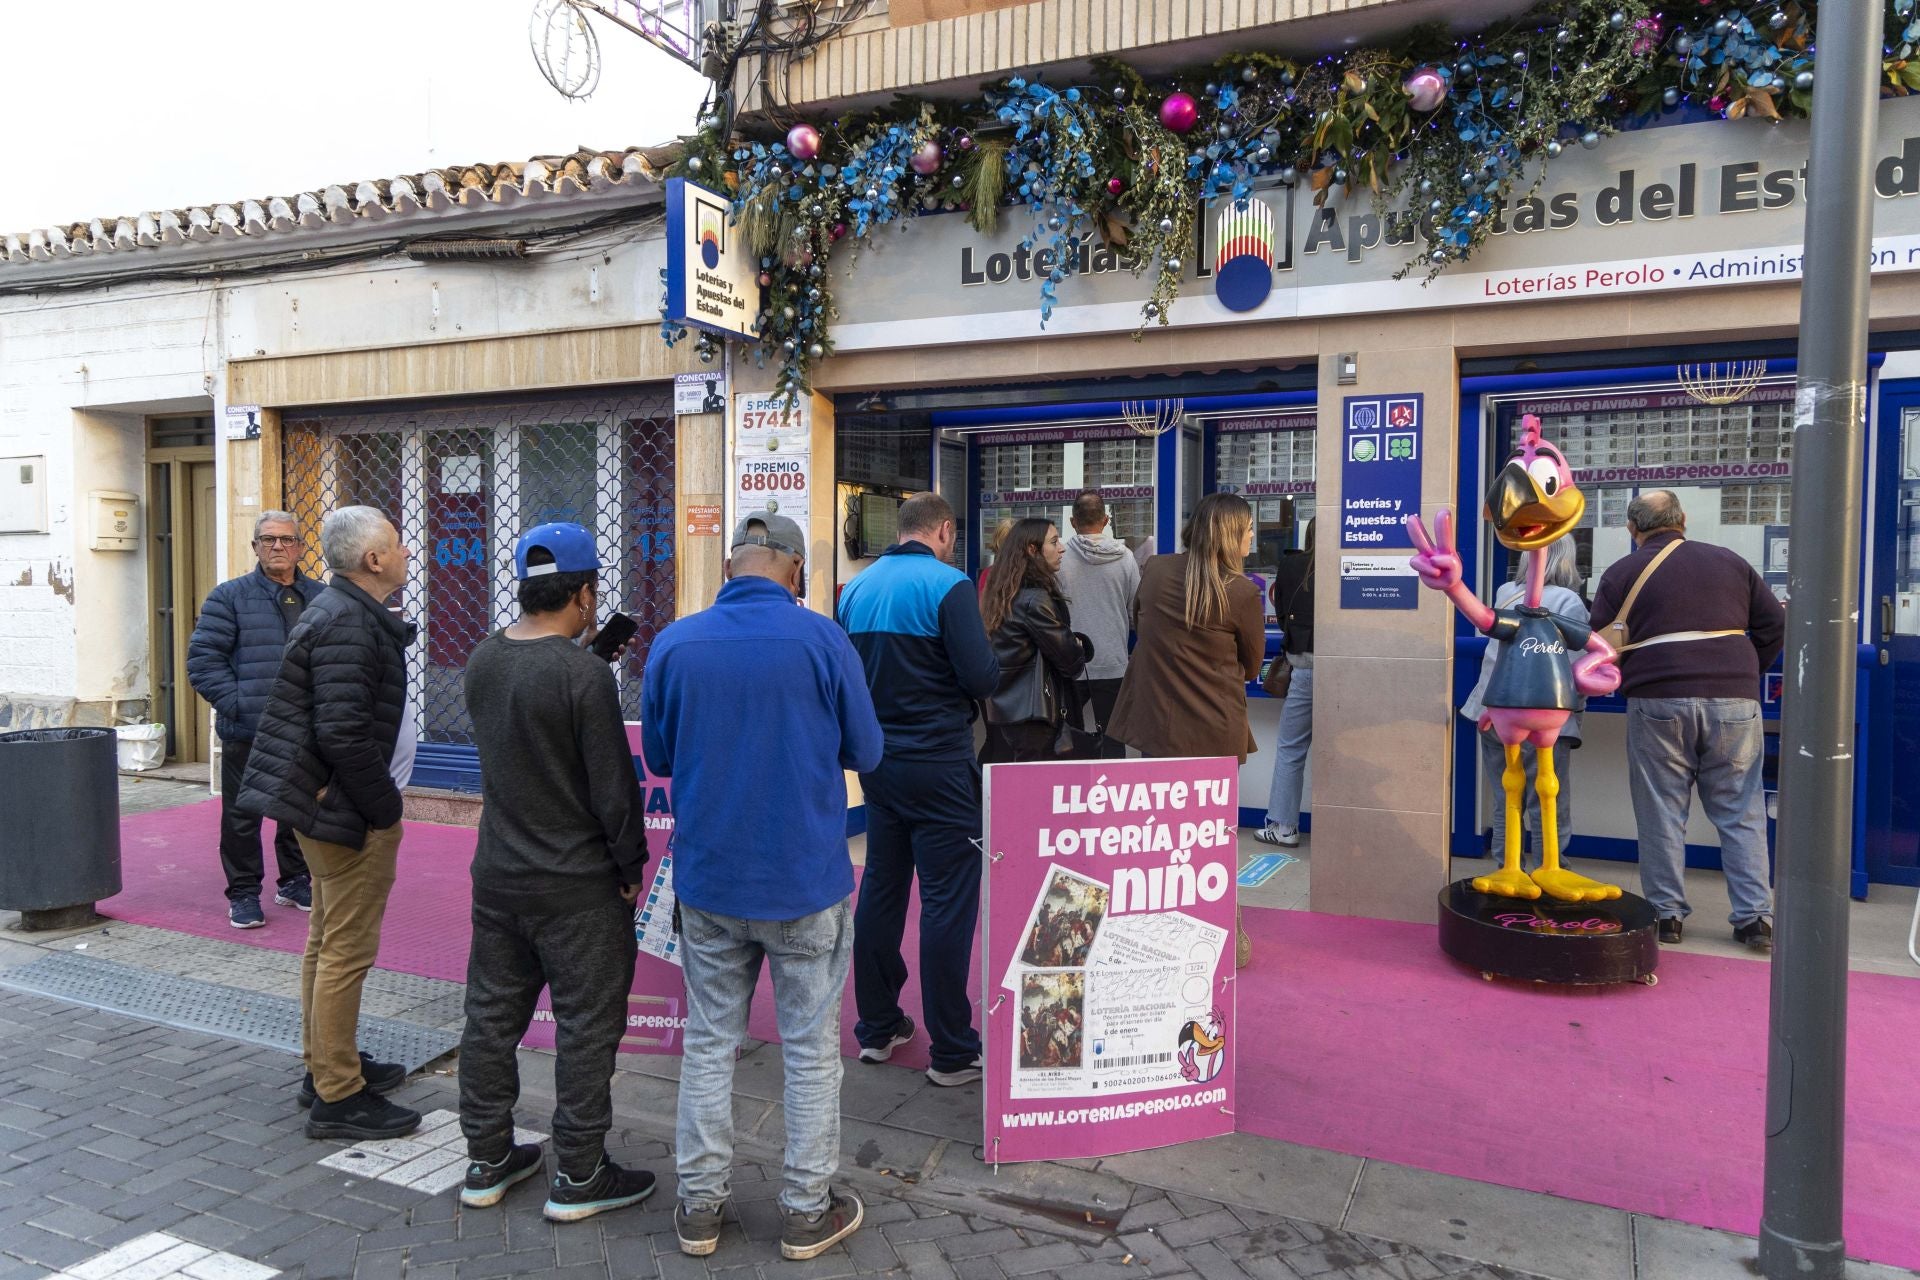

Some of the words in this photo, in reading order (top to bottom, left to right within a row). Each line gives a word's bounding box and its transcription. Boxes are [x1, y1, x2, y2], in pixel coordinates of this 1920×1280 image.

[1596, 163, 1696, 226] del
[728, 283, 733, 294] y
[1485, 273, 1577, 297] Loterías
[1586, 264, 1665, 289] Perolo
[697, 284, 732, 305] Apuestas
[733, 296, 744, 310] del
[696, 299, 723, 317] Estado
[677, 372, 722, 383] CONECTADA
[757, 399, 800, 410] PREMO
[754, 462, 800, 473] PREMIO
[741, 472, 806, 491] 88008
[1346, 497, 1391, 509] Loterías
[1394, 499, 1402, 511] y
[1345, 514, 1397, 528] Apuestas
[1345, 530, 1384, 542] Estado
[436, 538, 485, 567] 654
[636, 532, 671, 562] 15
[1519, 637, 1565, 656] Perolo
[1493, 913, 1621, 931] Perolo
[1103, 931, 1139, 949] LOTERÍA
[1141, 943, 1180, 961] NACIONA
[1091, 1004, 1130, 1016] LOTERÍA
[1132, 1001, 1177, 1012] NACIONAL
